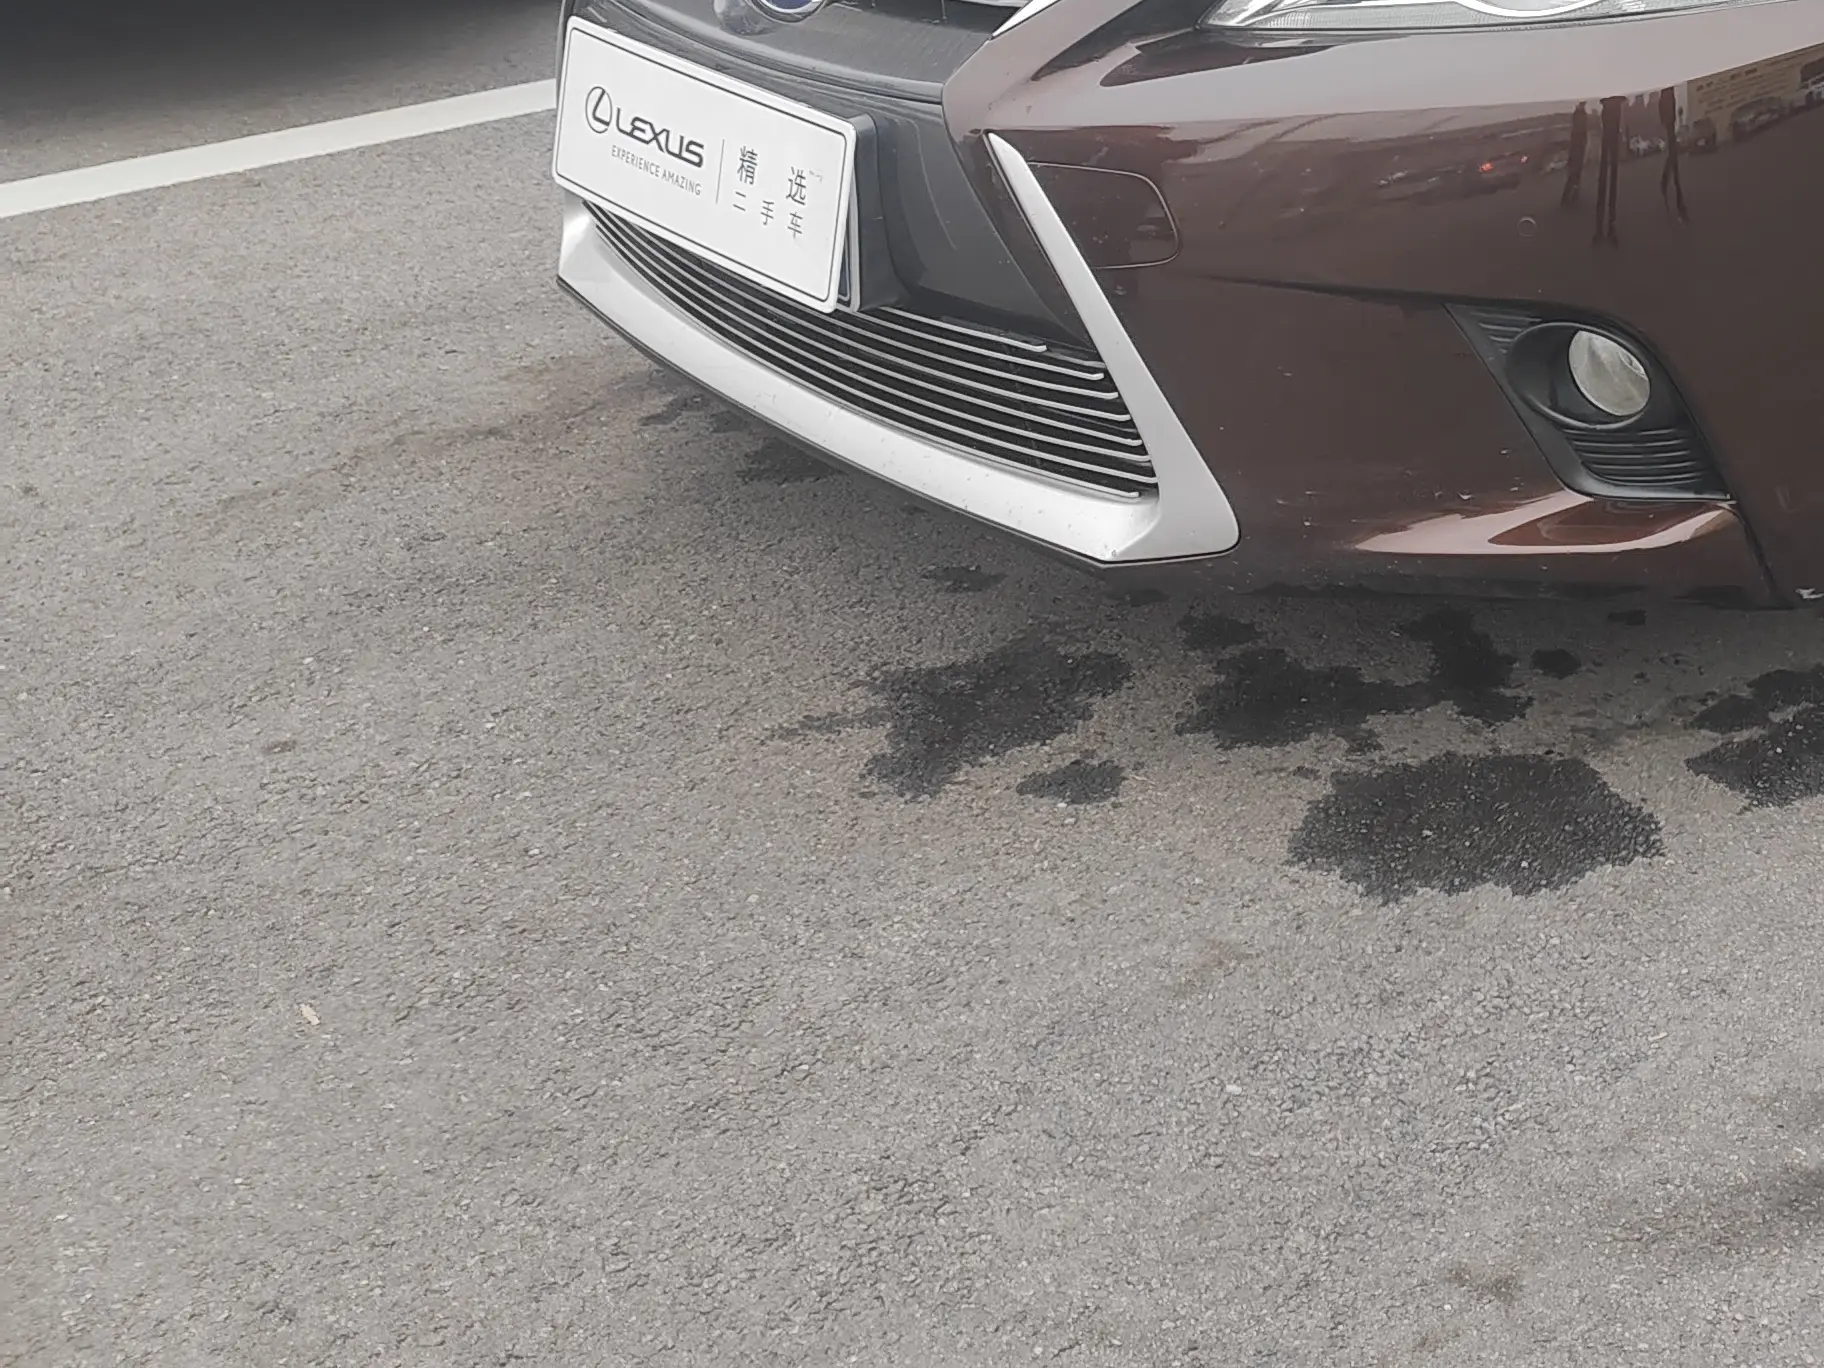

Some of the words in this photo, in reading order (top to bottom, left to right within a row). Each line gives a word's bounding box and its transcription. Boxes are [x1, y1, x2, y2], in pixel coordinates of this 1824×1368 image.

[616, 107, 704, 168] LEXUS
[612, 145, 660, 178] EXPERIENCE
[661, 169, 702, 196] AMAZING
[737, 146, 806, 206] 精选
[733, 191, 803, 239] 二手车
